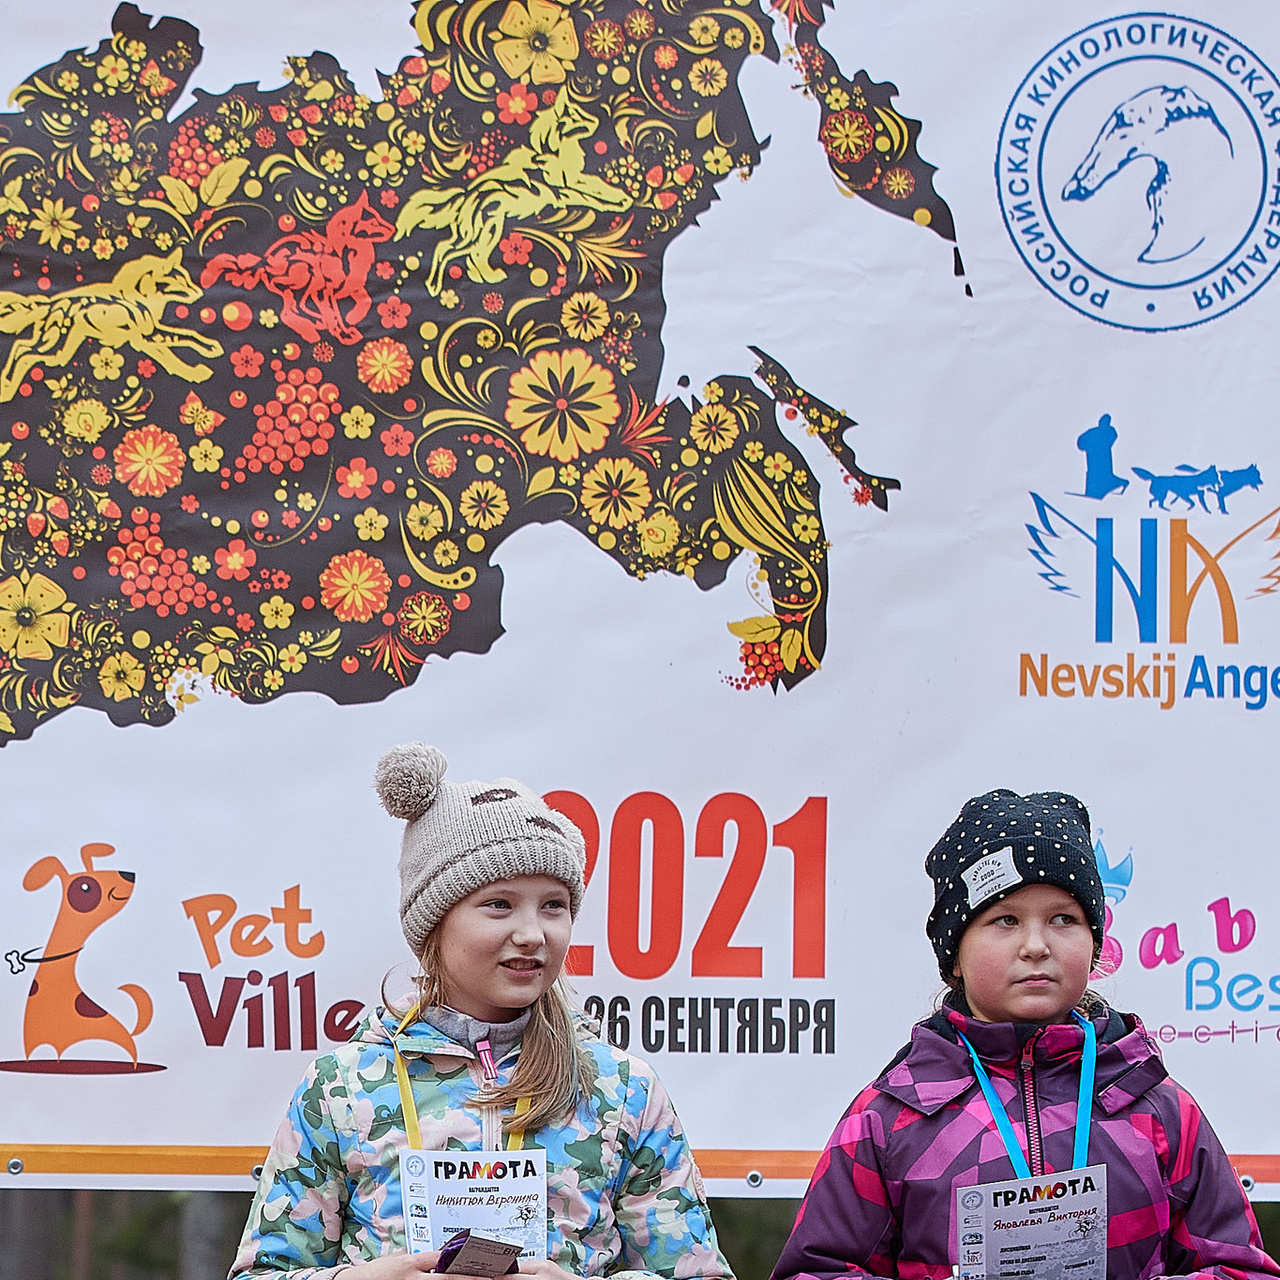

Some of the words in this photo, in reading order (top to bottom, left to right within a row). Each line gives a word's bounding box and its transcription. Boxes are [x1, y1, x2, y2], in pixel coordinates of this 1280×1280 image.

[1007, 112, 1110, 309] РОССИЙСКАЯ
[1019, 652, 1176, 710] Nevskij
[181, 884, 325, 969] Pet
[178, 969, 366, 1052] Ville
[641, 996, 836, 1055] СЕНТЯБРЯ
[433, 1159, 538, 1180] ГРАМОТА
[992, 1176, 1097, 1208] ГРАМОТА
